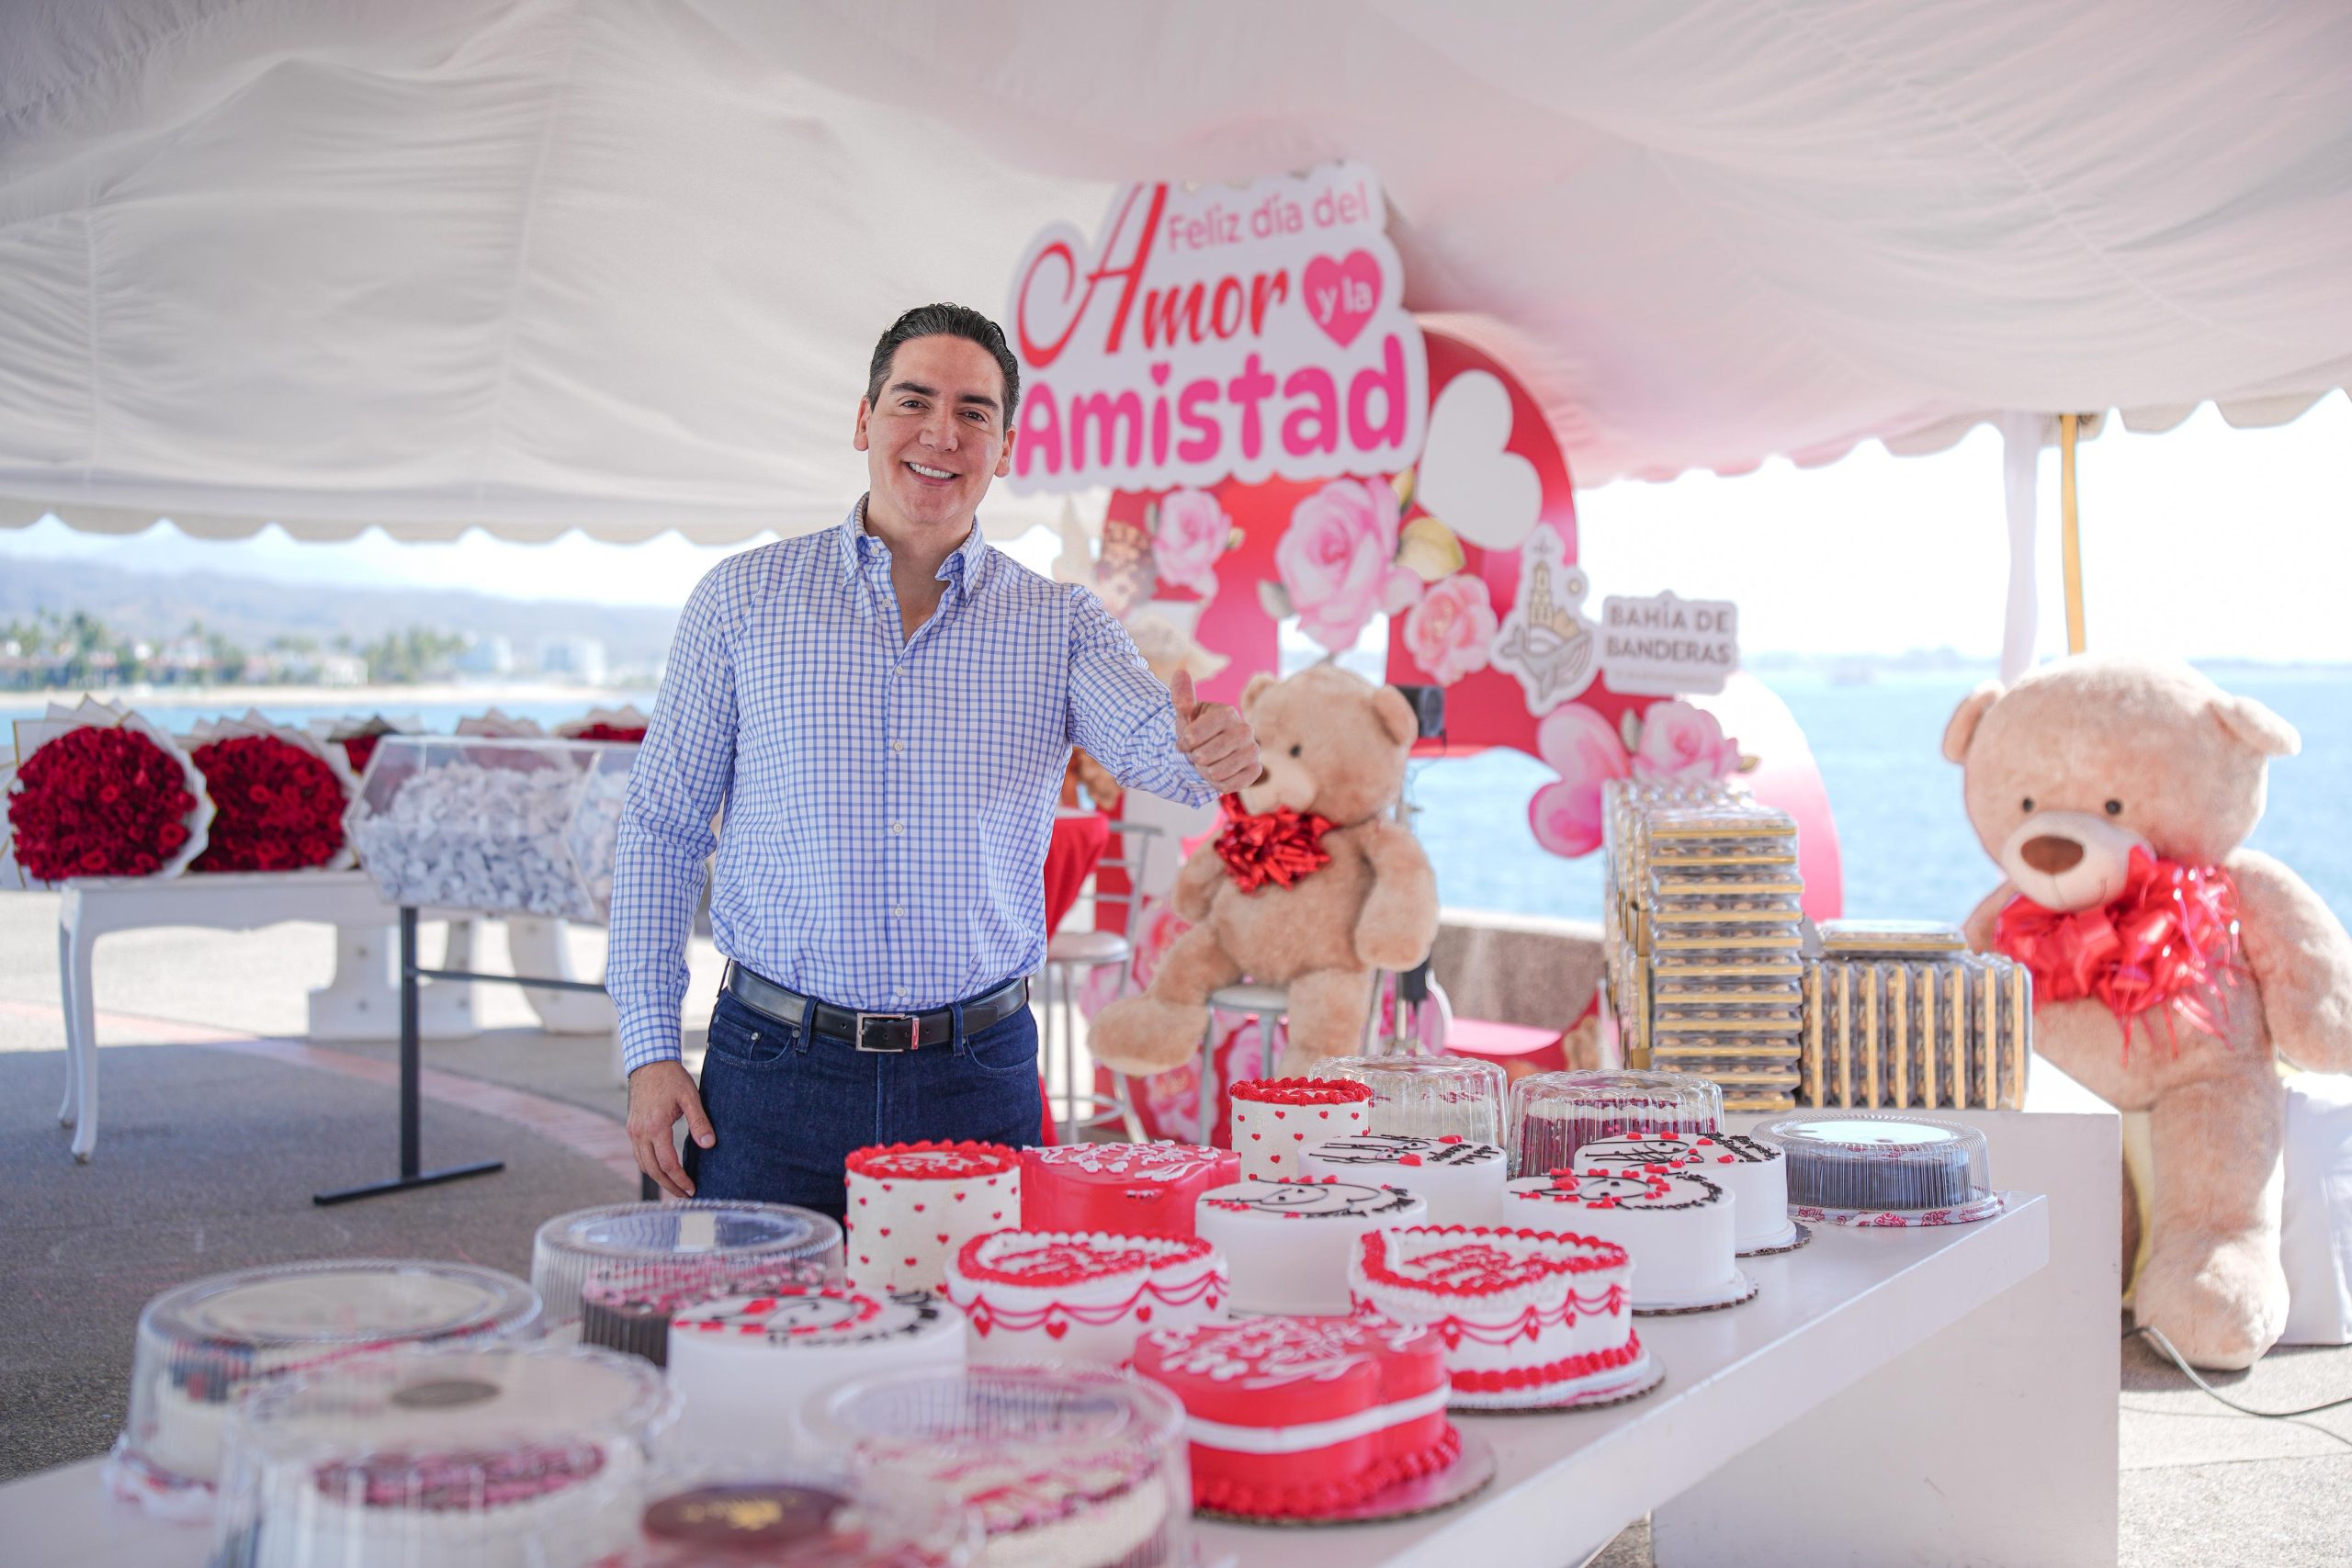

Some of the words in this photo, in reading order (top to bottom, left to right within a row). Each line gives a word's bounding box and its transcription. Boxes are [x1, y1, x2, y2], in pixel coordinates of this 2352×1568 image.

[1167, 204, 1242, 253] Feliz
[1250, 195, 1304, 241] día
[1312, 182, 1370, 229] del
[1017, 183, 1290, 368] Amor
[1314, 283, 1337, 325] y
[1342, 275, 1374, 313] la
[1015, 333, 1408, 478] Amistad
[1610, 601, 1687, 630] BAHÍA
[1694, 609, 1730, 634] DE
[1607, 637, 1731, 666] BANDERAS
